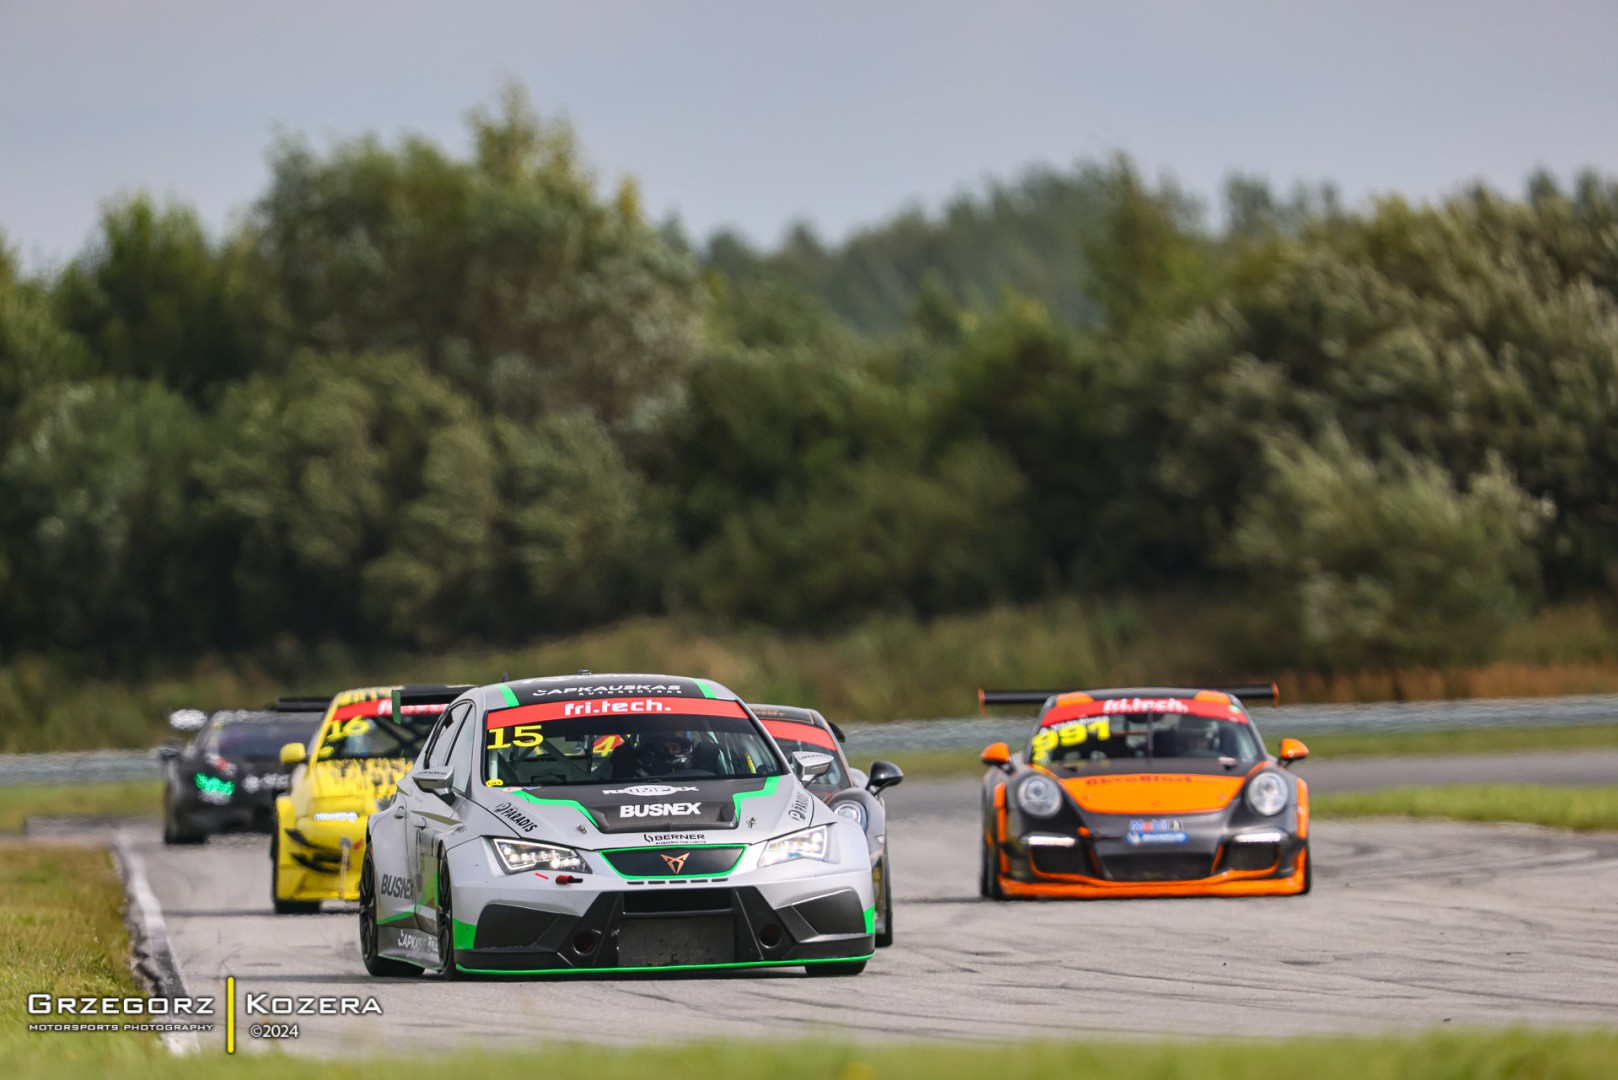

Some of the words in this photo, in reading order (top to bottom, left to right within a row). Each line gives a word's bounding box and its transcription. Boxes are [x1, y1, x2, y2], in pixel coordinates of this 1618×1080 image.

[564, 698, 672, 716] fri.tech.
[326, 715, 370, 742] 16
[487, 724, 544, 750] 15
[593, 735, 616, 757] 4
[501, 807, 538, 833] PARADIS
[620, 802, 702, 818] BUSNEX
[655, 833, 706, 841] BERNER
